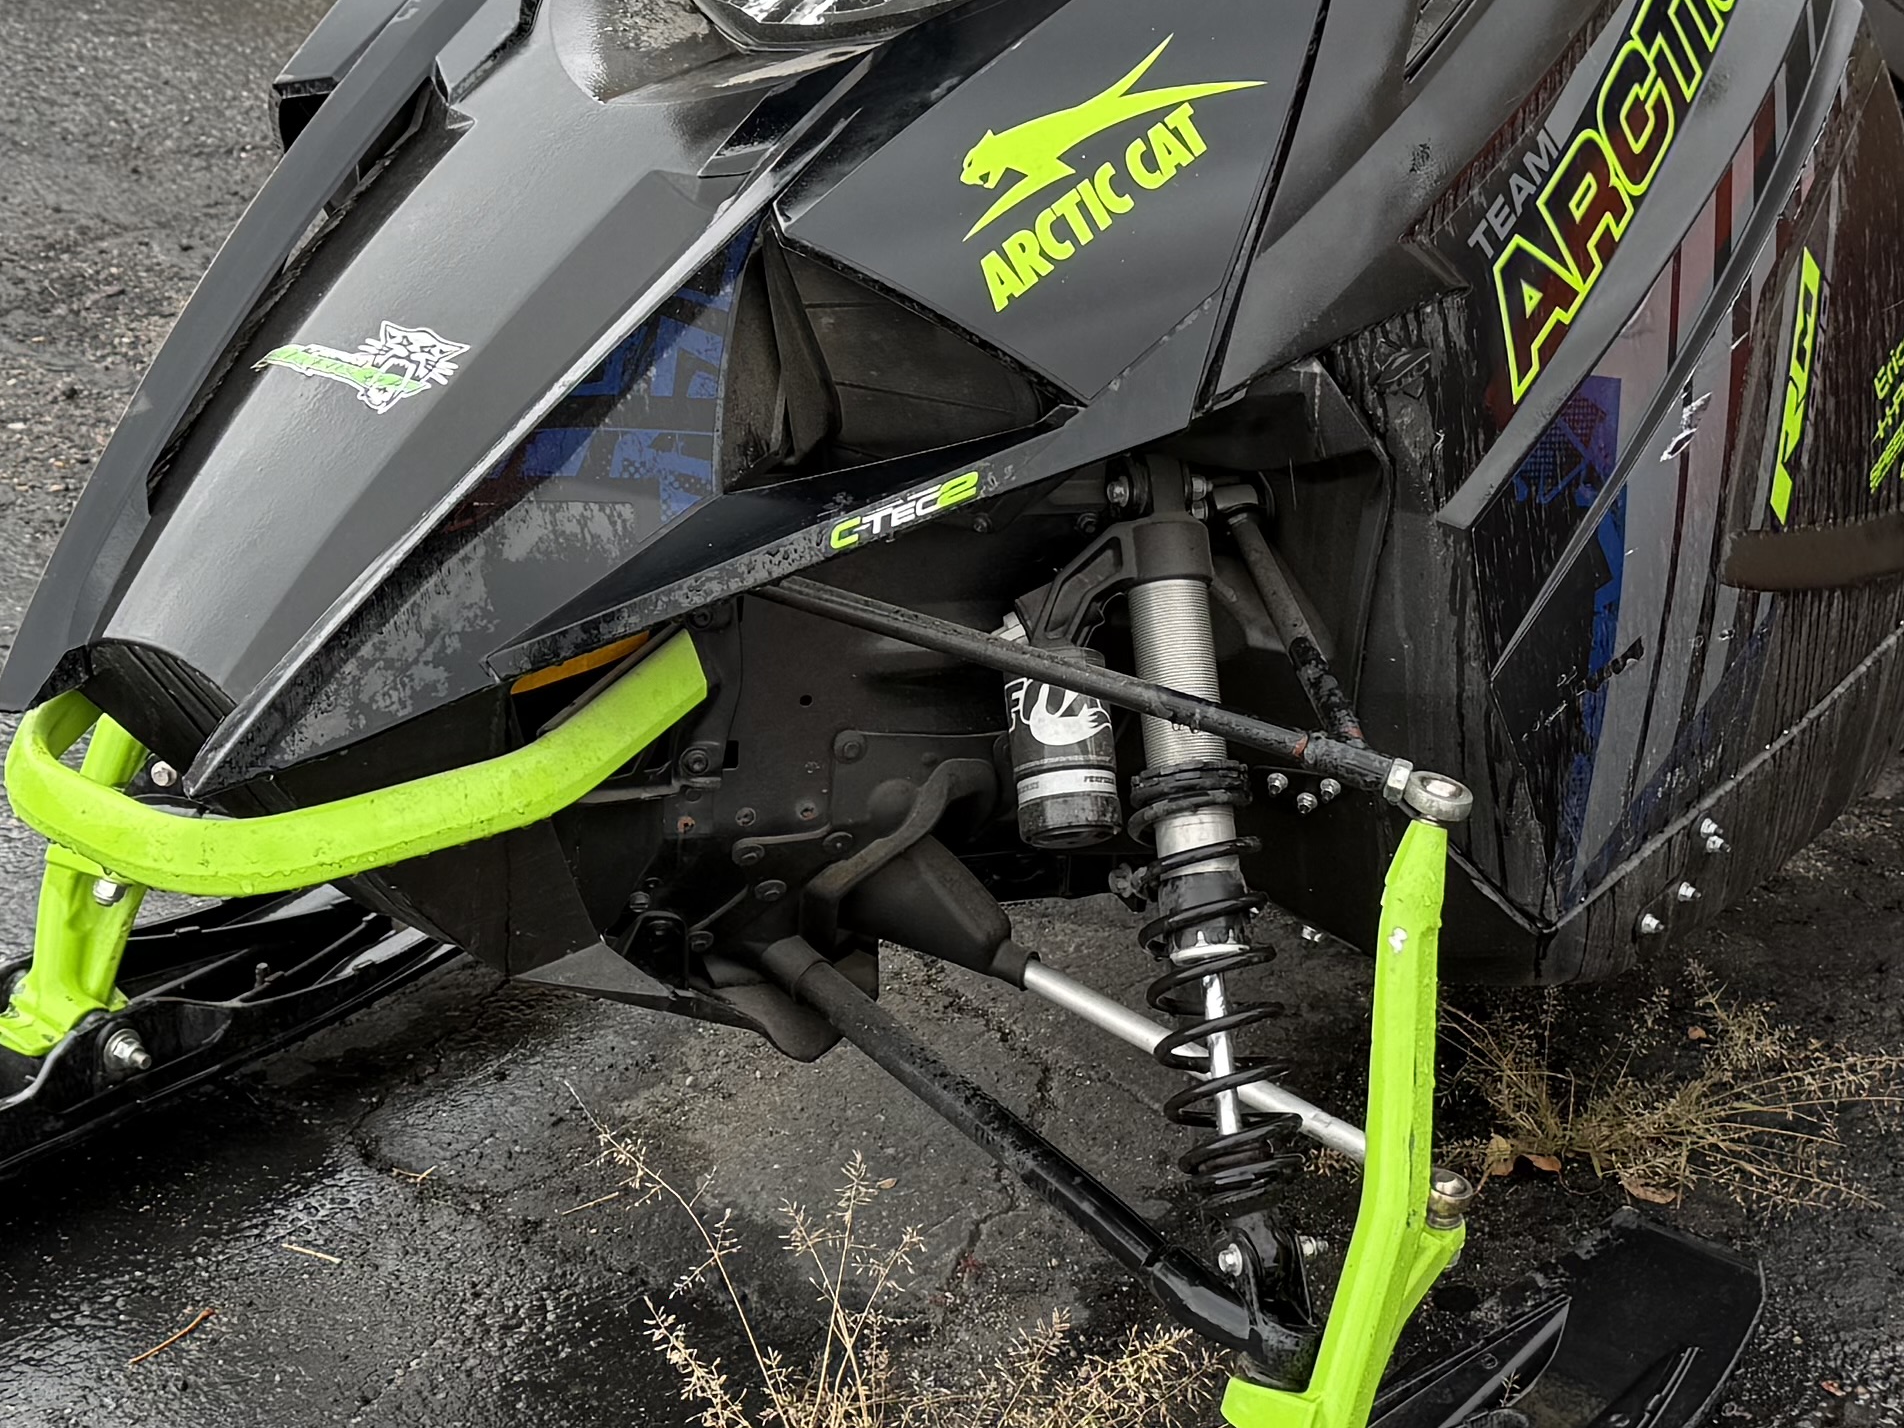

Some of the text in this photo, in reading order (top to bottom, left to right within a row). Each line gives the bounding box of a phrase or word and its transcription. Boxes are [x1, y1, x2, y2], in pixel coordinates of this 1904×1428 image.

[980, 101, 1208, 313] ARCTIC CAT
[1467, 128, 1559, 260] TEAM
